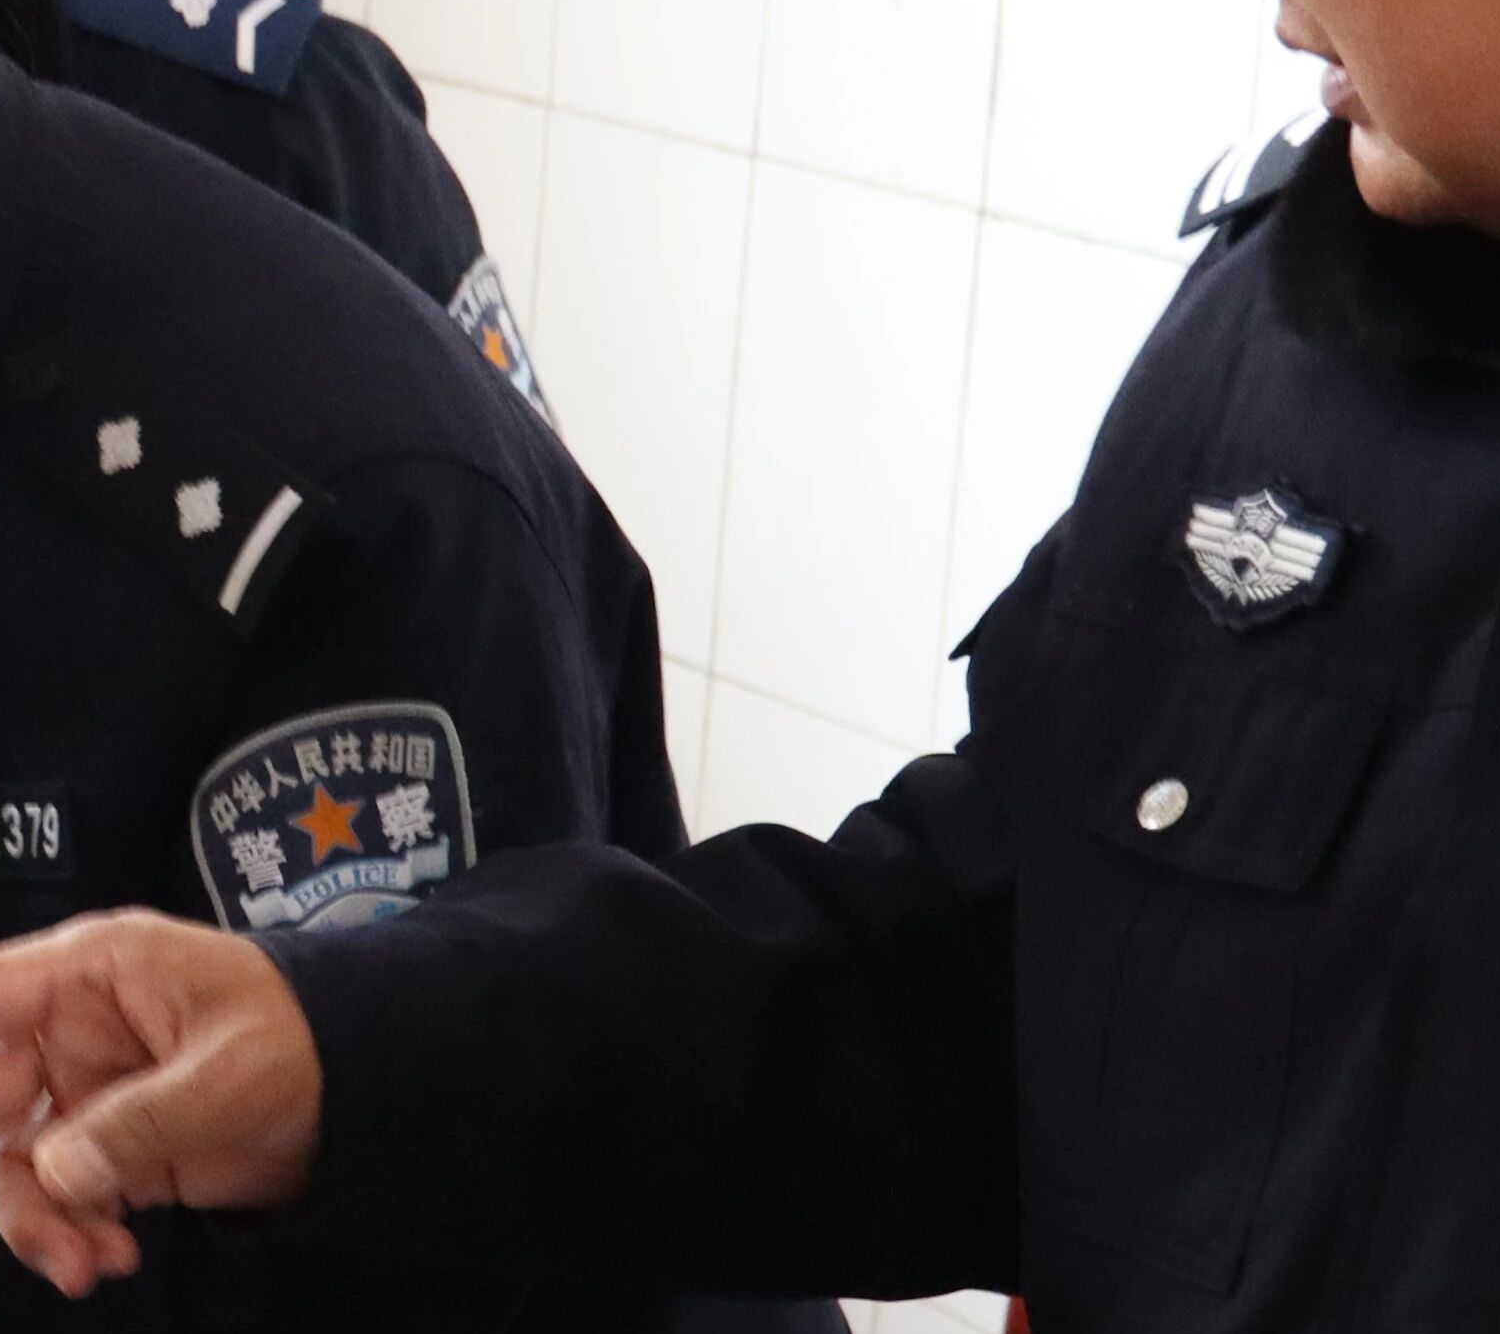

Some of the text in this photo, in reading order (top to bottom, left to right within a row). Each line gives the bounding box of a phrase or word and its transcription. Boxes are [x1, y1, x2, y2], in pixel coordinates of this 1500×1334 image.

[209, 731, 436, 835] 中华人民共和国
[293, 865, 400, 912] POLICE
